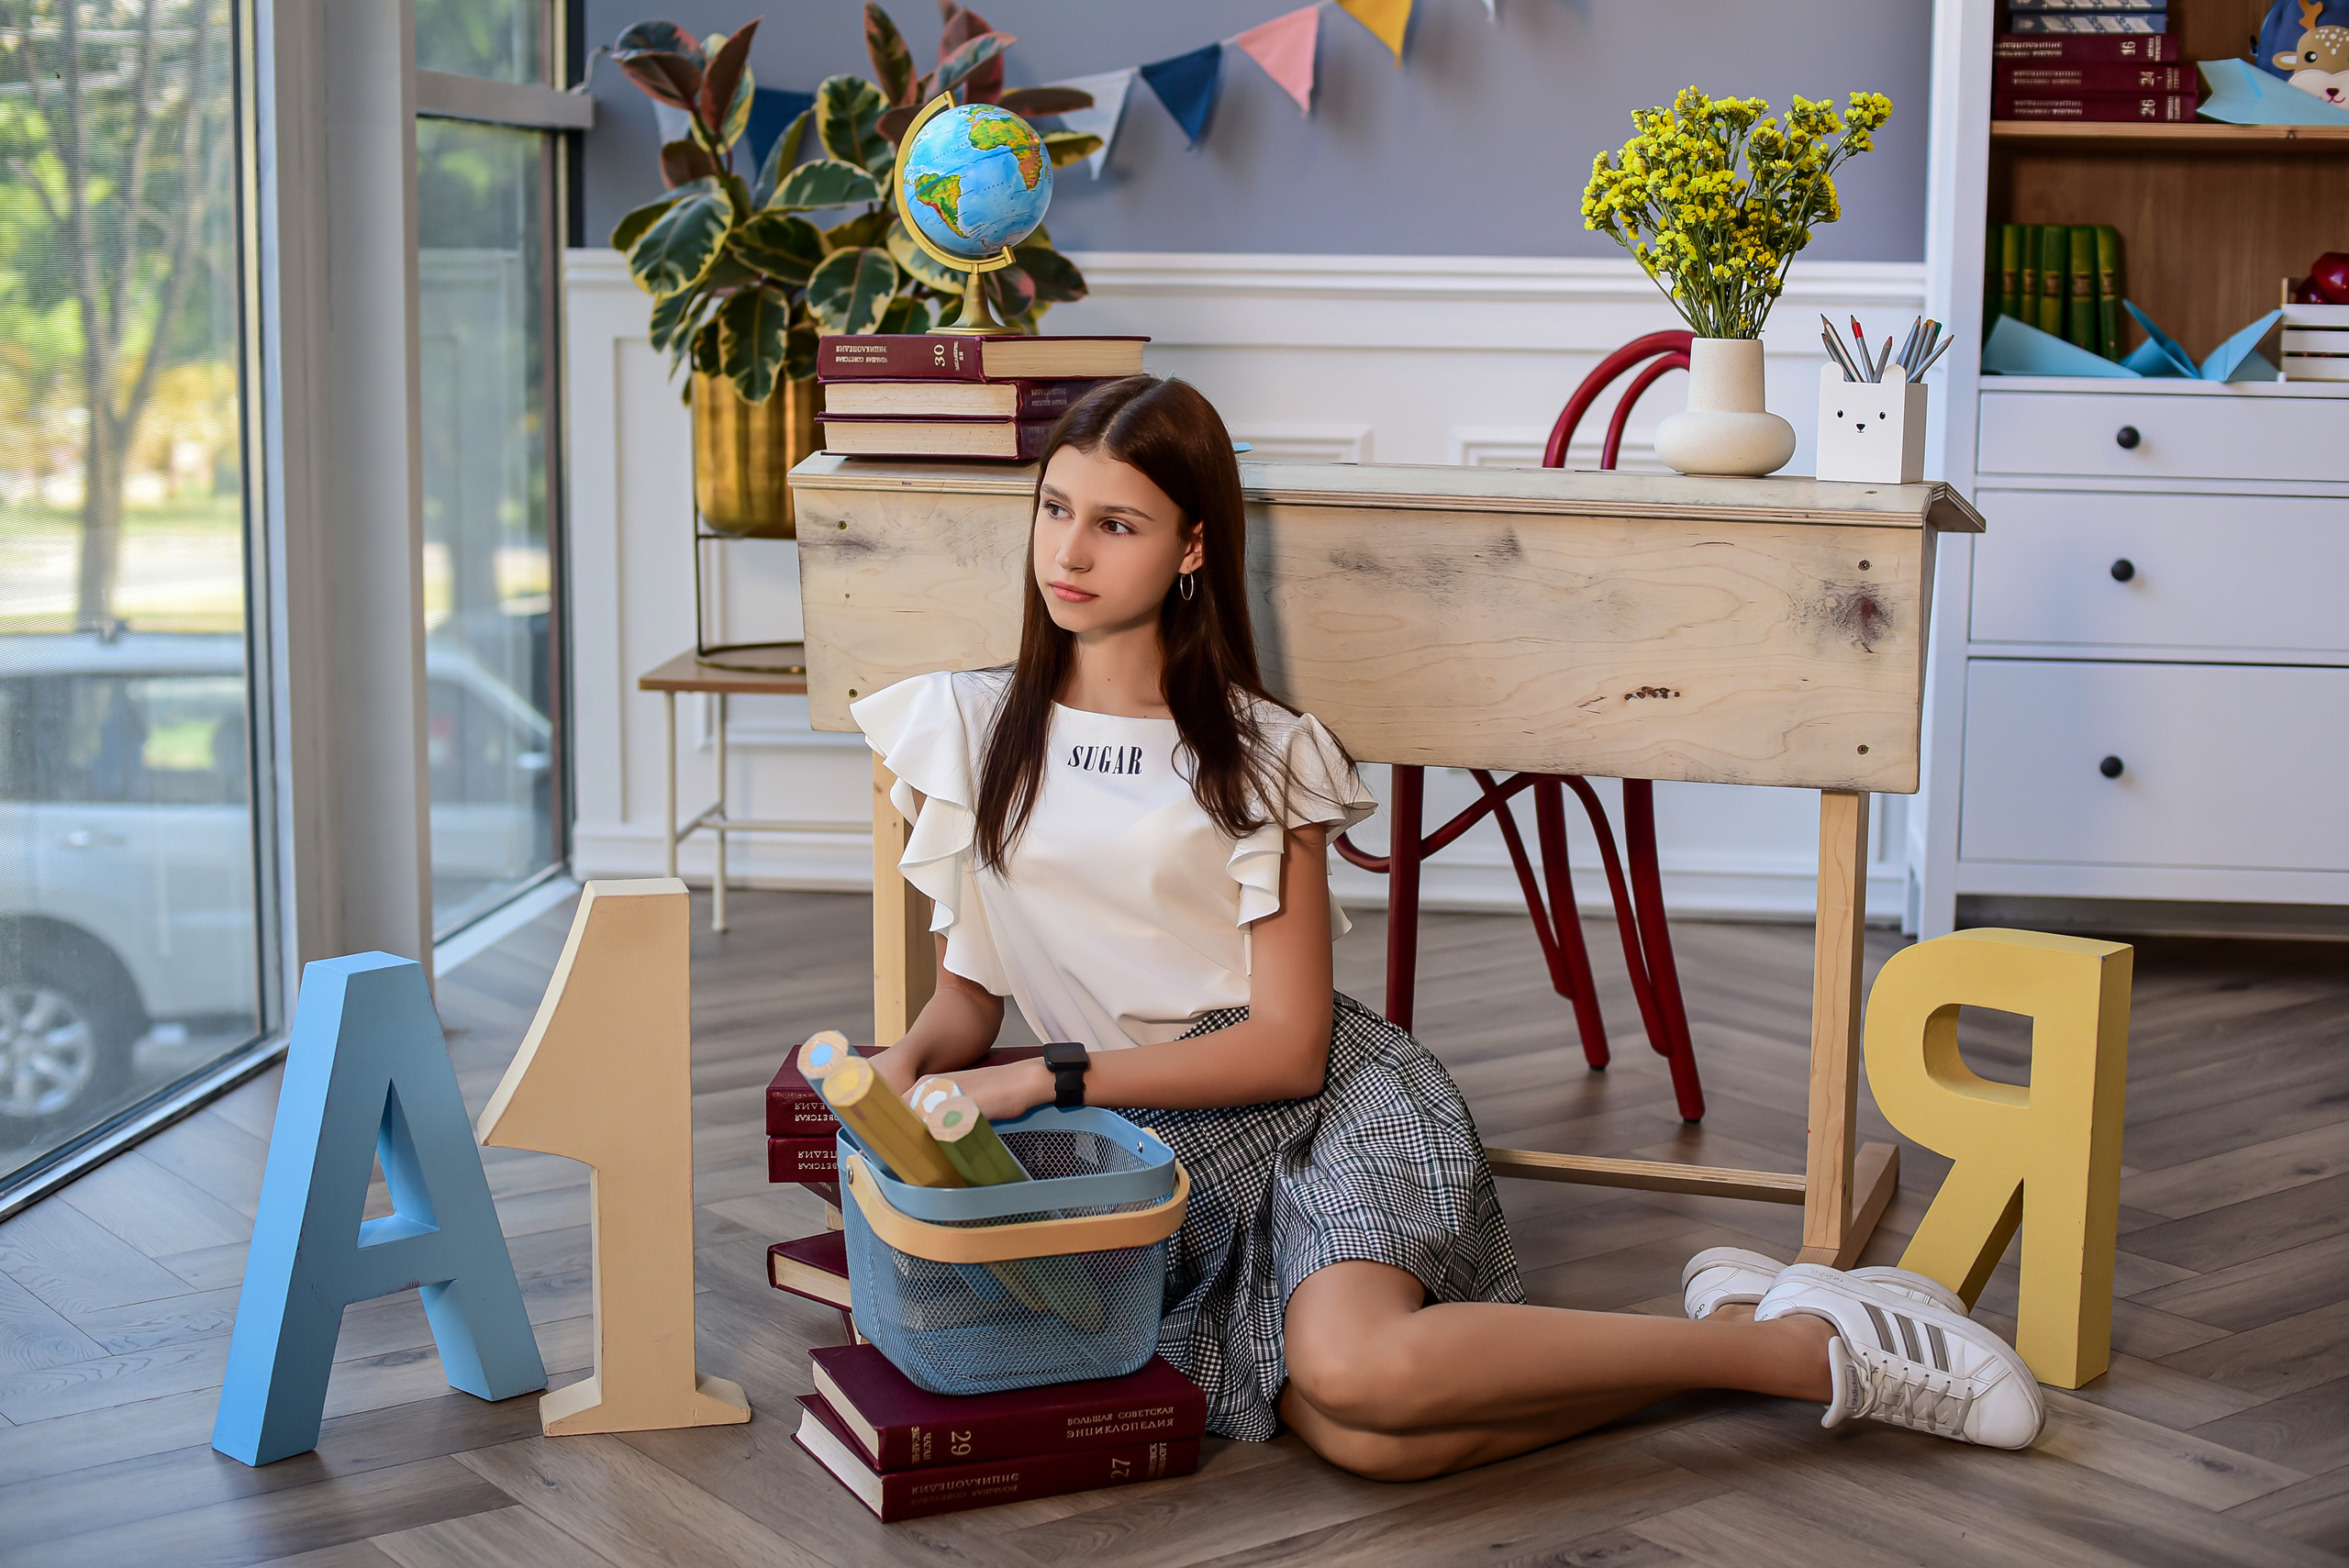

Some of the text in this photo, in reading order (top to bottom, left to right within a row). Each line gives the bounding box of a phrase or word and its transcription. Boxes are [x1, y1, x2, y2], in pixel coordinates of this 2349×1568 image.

[2121, 41, 2136, 56] 16
[2139, 71, 2154, 87] 24
[2139, 98, 2156, 117] 26
[933, 344, 946, 367] 30
[1066, 745, 1143, 775] SUGAR
[1809, 1269, 1843, 1283] adidas
[1851, 1369, 1859, 1407] adidas
[1066, 1406, 1174, 1426] БОЛЬШАЯ СОВЕТСКАЯ
[1065, 1418, 1174, 1439] ЭНЦИКЛОПЕДИЯ
[951, 1430, 972, 1456] 29
[1110, 1458, 1130, 1479] 27
[911, 1473, 1019, 1496] ЭНЦИКЛОПЕДИЯ
[971, 1485, 1018, 1496] БОЛЬШАЯ
